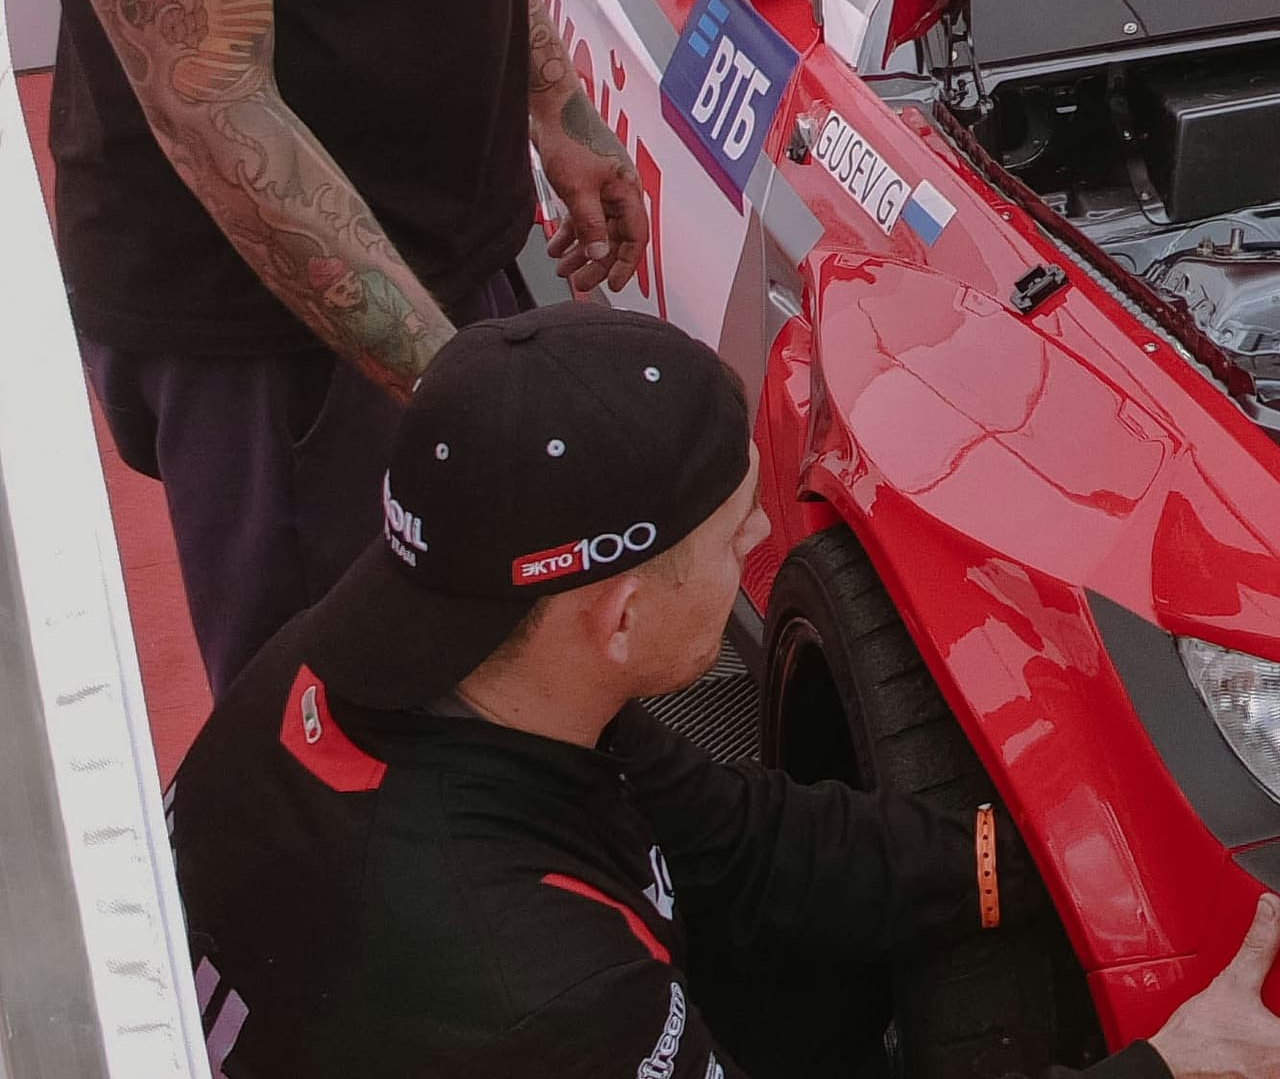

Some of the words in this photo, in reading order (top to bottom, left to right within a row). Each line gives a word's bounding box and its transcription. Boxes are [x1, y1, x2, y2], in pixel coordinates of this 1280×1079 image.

[691, 34, 771, 161] ВТБ
[815, 114, 878, 206] GUSEV
[876, 179, 903, 232] G.
[521, 552, 573, 577] ЭКТО
[573, 522, 657, 571] 100
